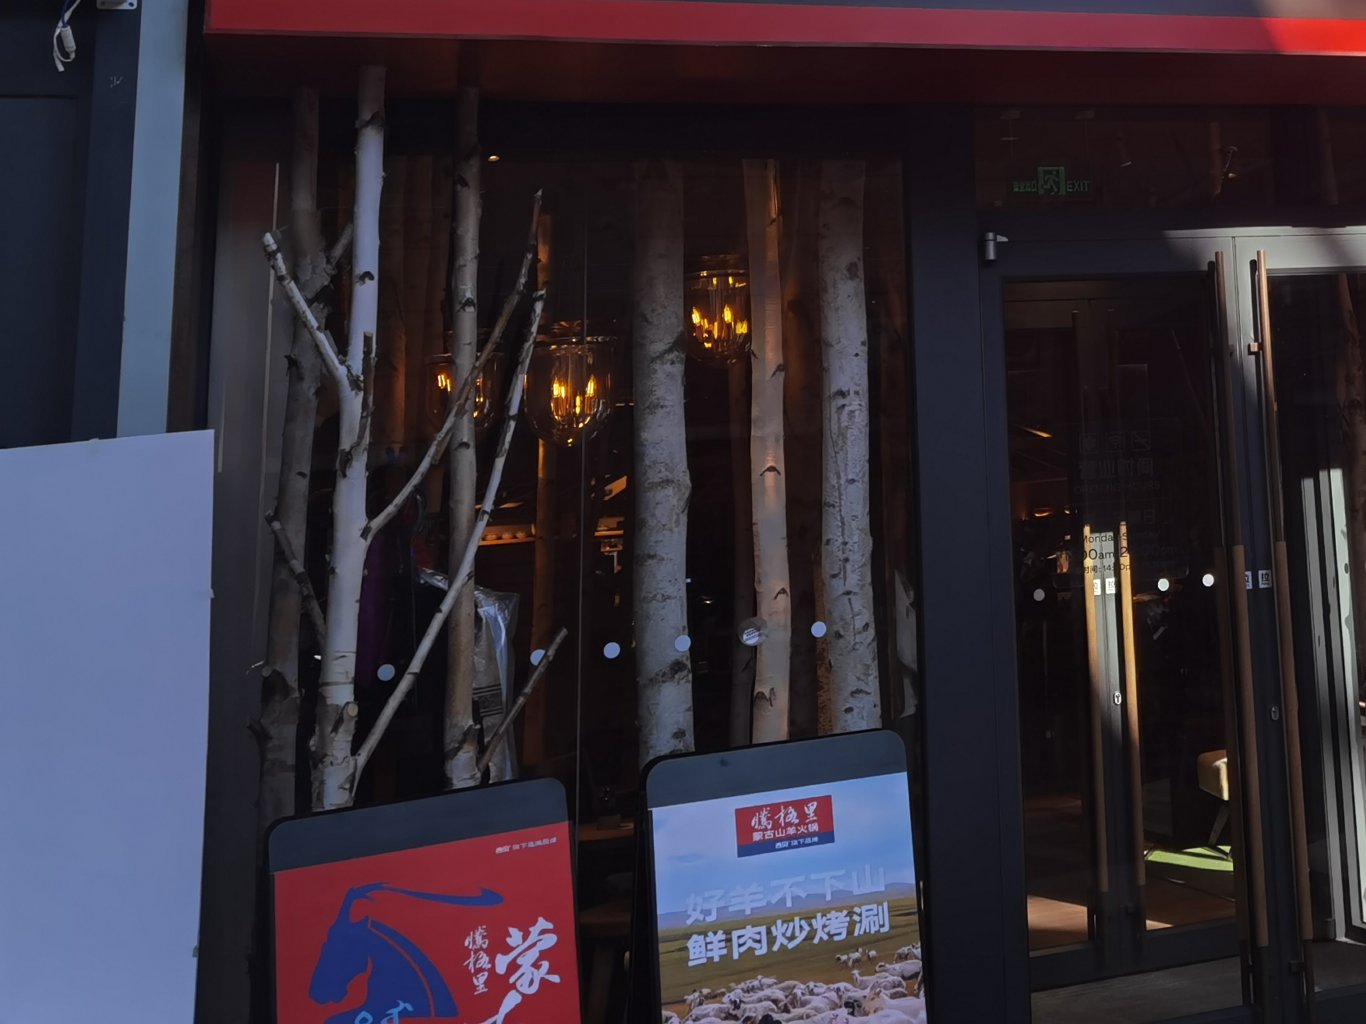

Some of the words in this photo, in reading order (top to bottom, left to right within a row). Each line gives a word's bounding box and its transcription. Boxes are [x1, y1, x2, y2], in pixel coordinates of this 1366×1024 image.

[1066, 180, 1089, 192] EXIT
[752, 823, 819, 842] 蒙古山羊火锅
[685, 863, 886, 926] 好羊不下山
[686, 900, 891, 968] 鲜肉炒烤涮
